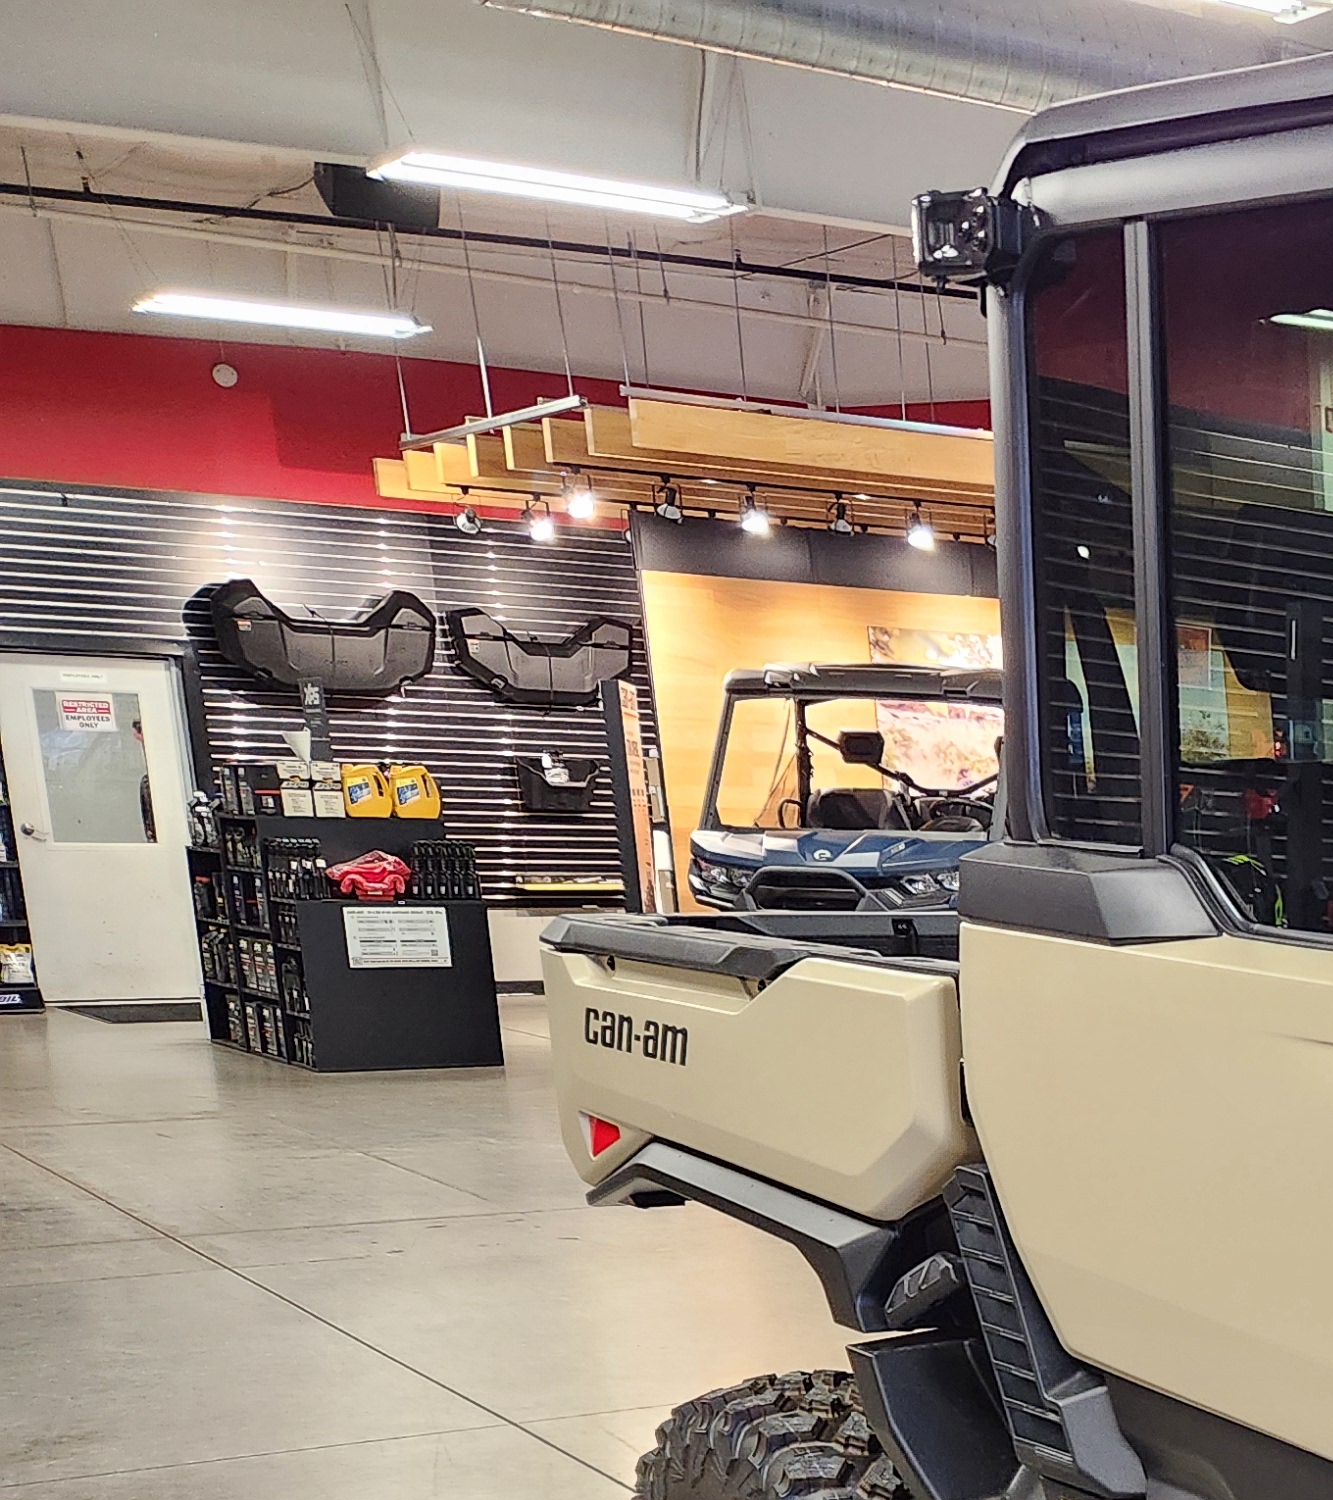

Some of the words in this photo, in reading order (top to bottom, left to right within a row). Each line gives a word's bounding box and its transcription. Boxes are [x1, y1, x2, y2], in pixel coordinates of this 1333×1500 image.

[63, 700, 109, 709] RESTRICTED
[65, 714, 110, 722] EMPLOYEES
[585, 1007, 688, 1067] can-am
